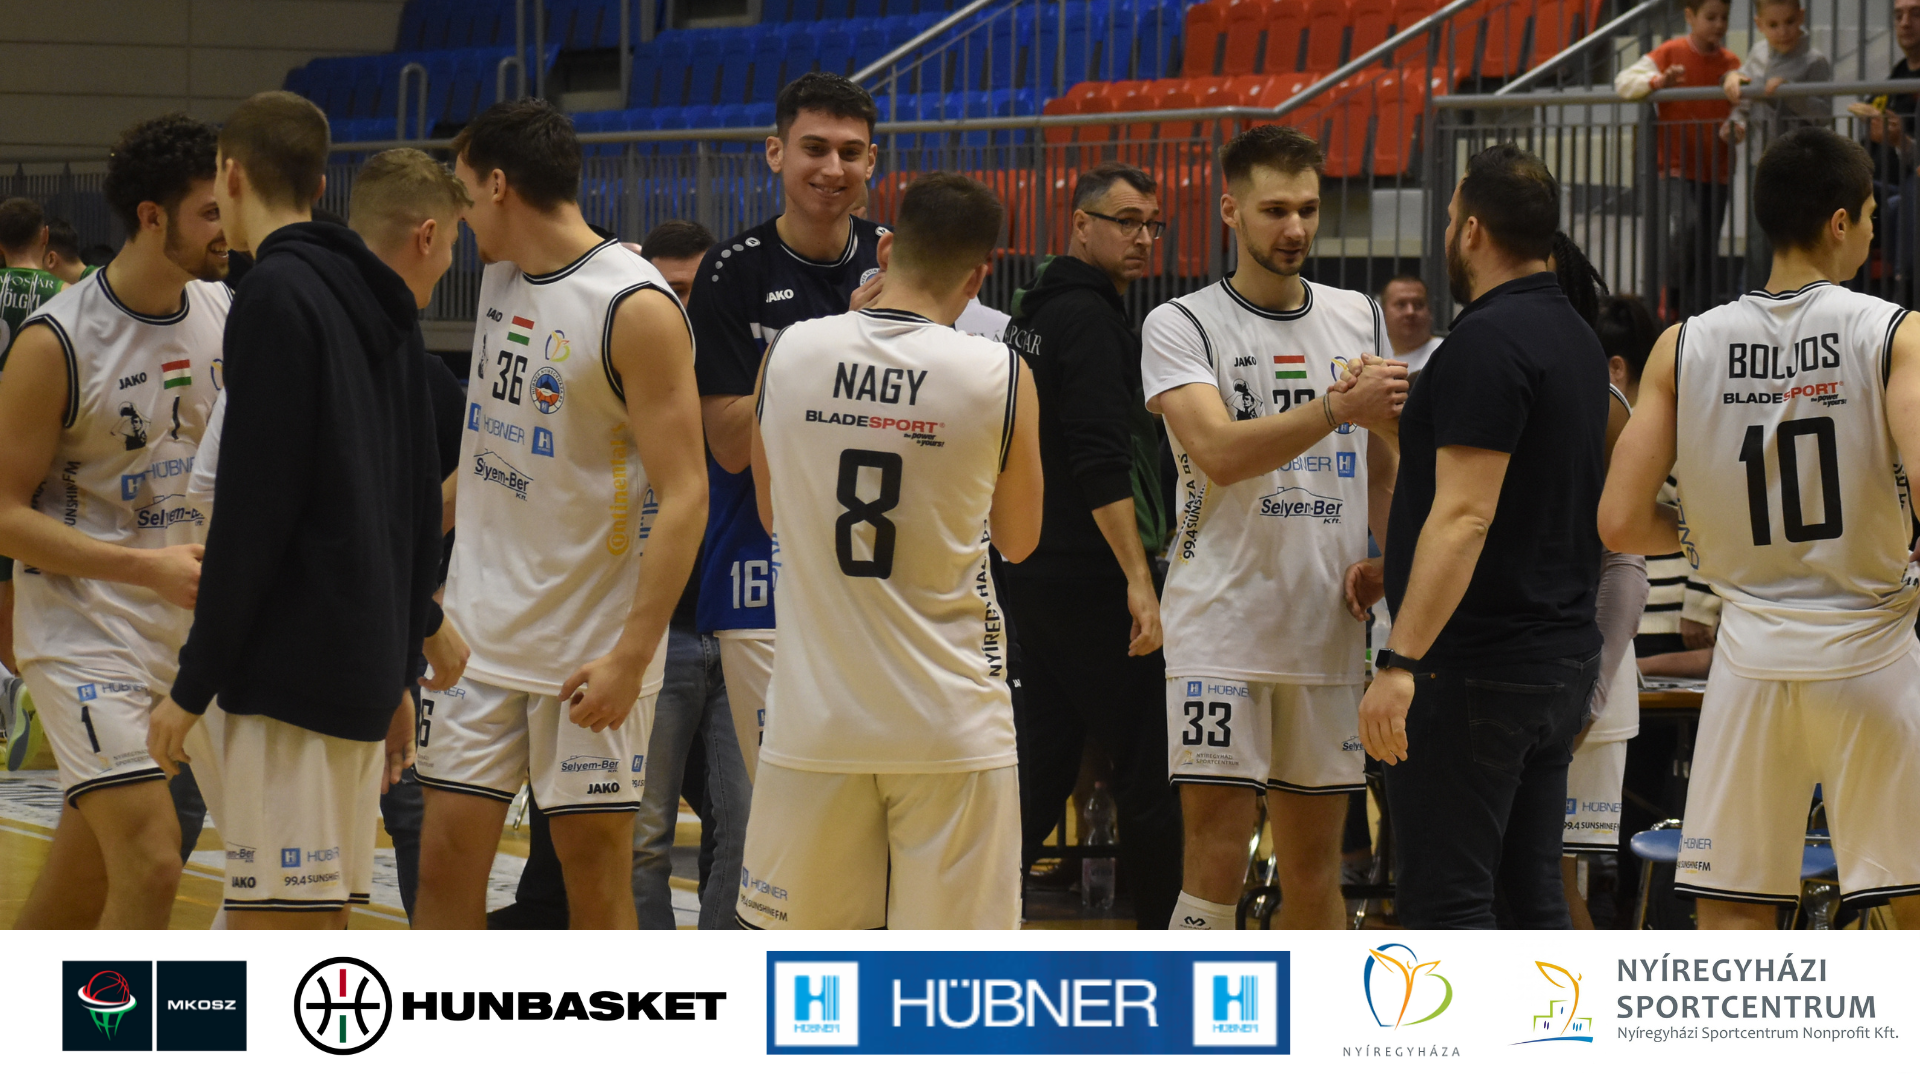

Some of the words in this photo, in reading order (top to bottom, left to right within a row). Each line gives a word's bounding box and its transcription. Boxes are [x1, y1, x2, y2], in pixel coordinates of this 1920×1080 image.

[492, 350, 528, 406] 36
[1234, 356, 1257, 368] JAKO
[1729, 333, 1840, 380] BOLJOS
[119, 371, 147, 390] JAKO
[833, 362, 928, 406] NAGY
[1739, 416, 1843, 546] 10
[835, 449, 903, 579] 8
[730, 560, 768, 609] 16
[82, 705, 101, 753] 1
[1183, 701, 1231, 747] 33
[561, 759, 620, 772] Selyem-Ber
[587, 782, 620, 794] JAKO
[284, 875, 306, 886] 99.4
